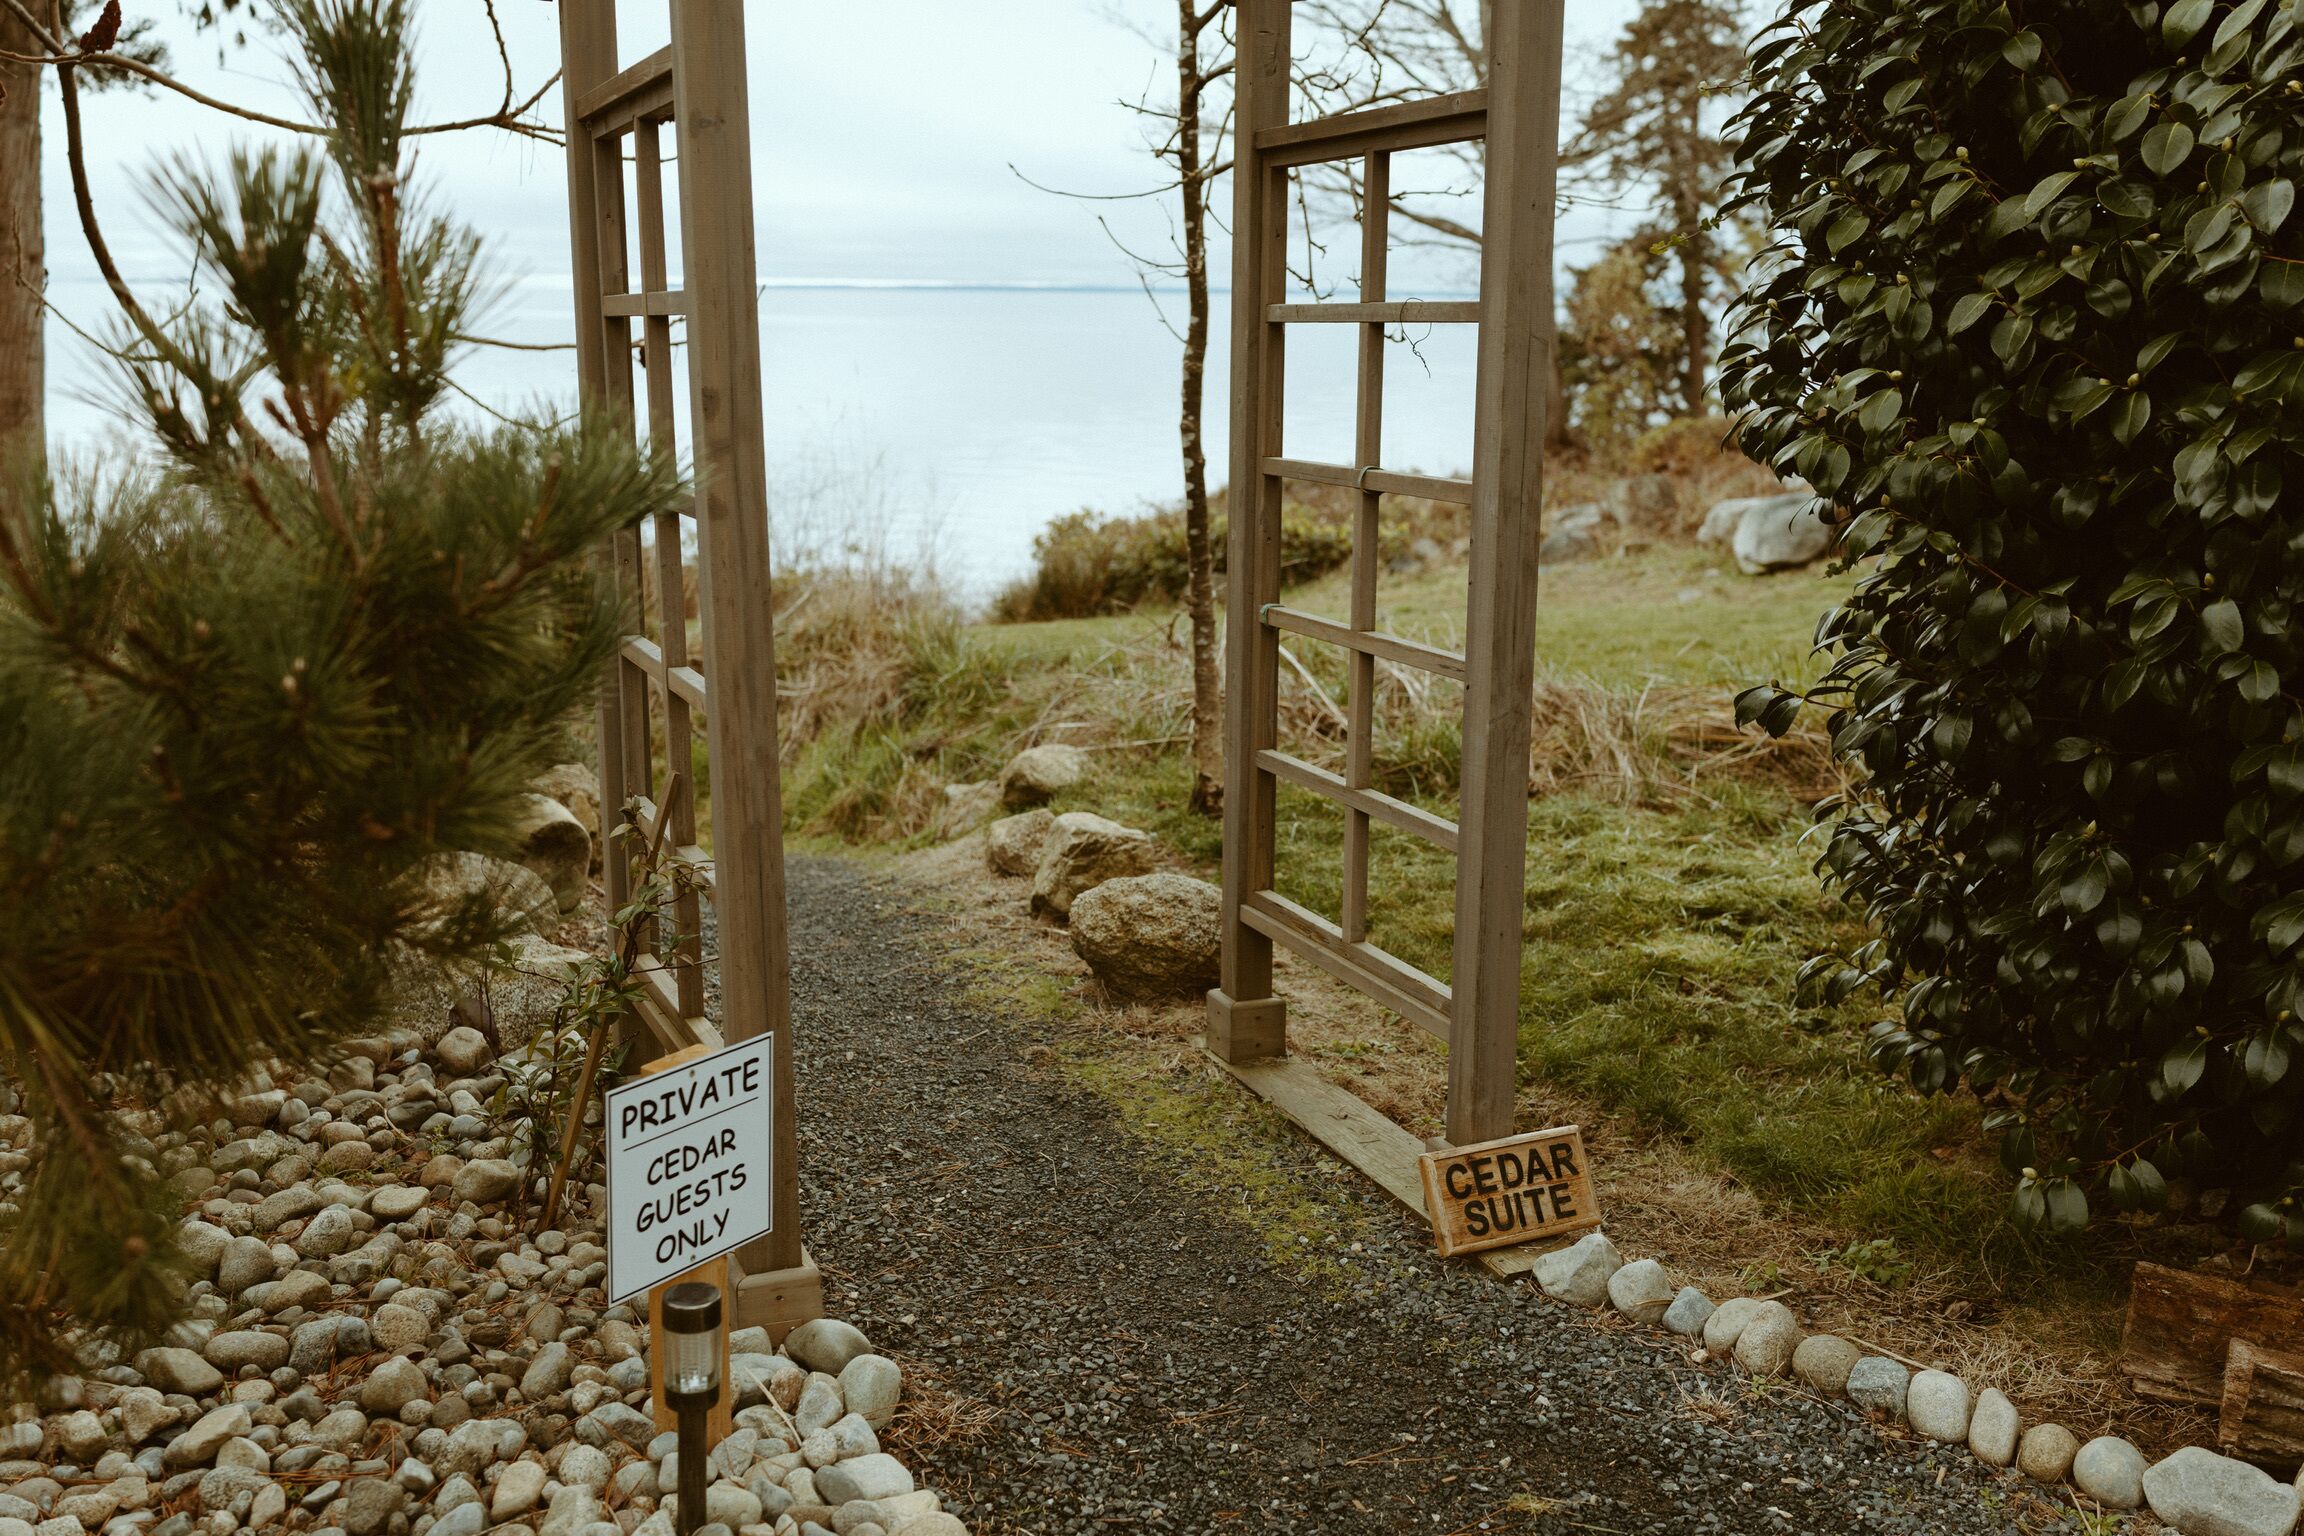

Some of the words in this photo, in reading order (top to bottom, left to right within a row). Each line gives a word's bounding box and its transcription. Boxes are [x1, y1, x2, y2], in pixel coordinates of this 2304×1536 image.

[622, 1057, 759, 1139] PRIVATE
[647, 1128, 736, 1185] CEDAR
[1445, 1142, 1580, 1199] CEDAR
[636, 1163, 747, 1232] GUESTS
[1464, 1182, 1577, 1236] SUITE
[656, 1208, 730, 1263] ONLY
